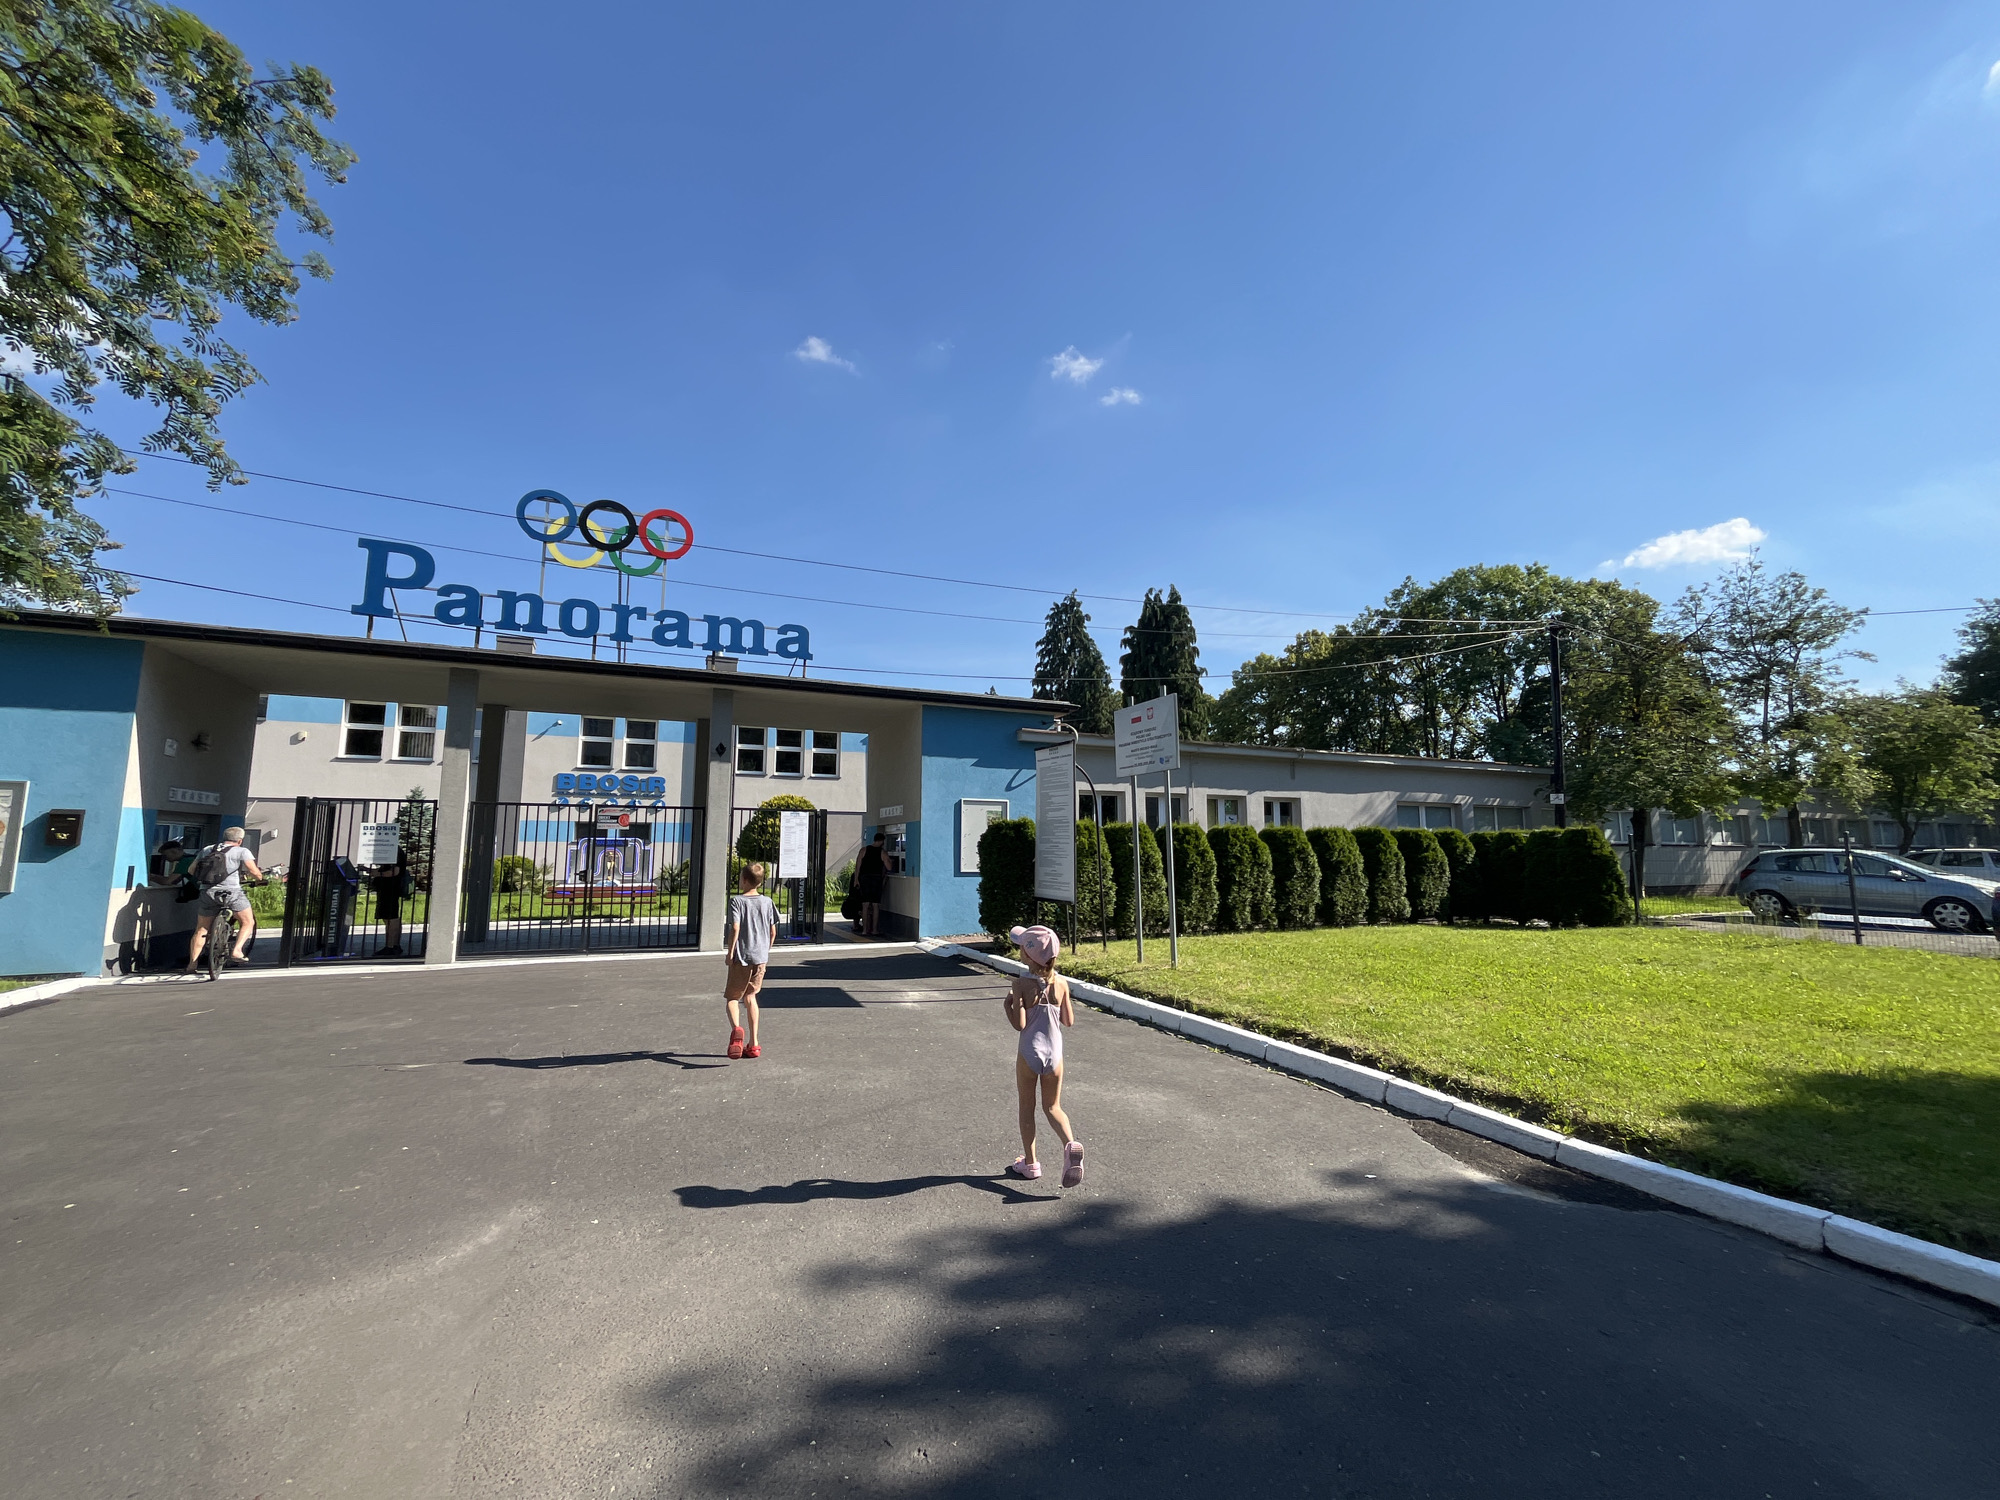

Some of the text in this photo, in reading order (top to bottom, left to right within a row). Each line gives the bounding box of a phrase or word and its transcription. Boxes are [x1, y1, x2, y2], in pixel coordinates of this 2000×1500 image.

[351, 537, 813, 661] Panorama
[557, 772, 666, 793] BBOSiR
[797, 878, 805, 921] BILETOMA
